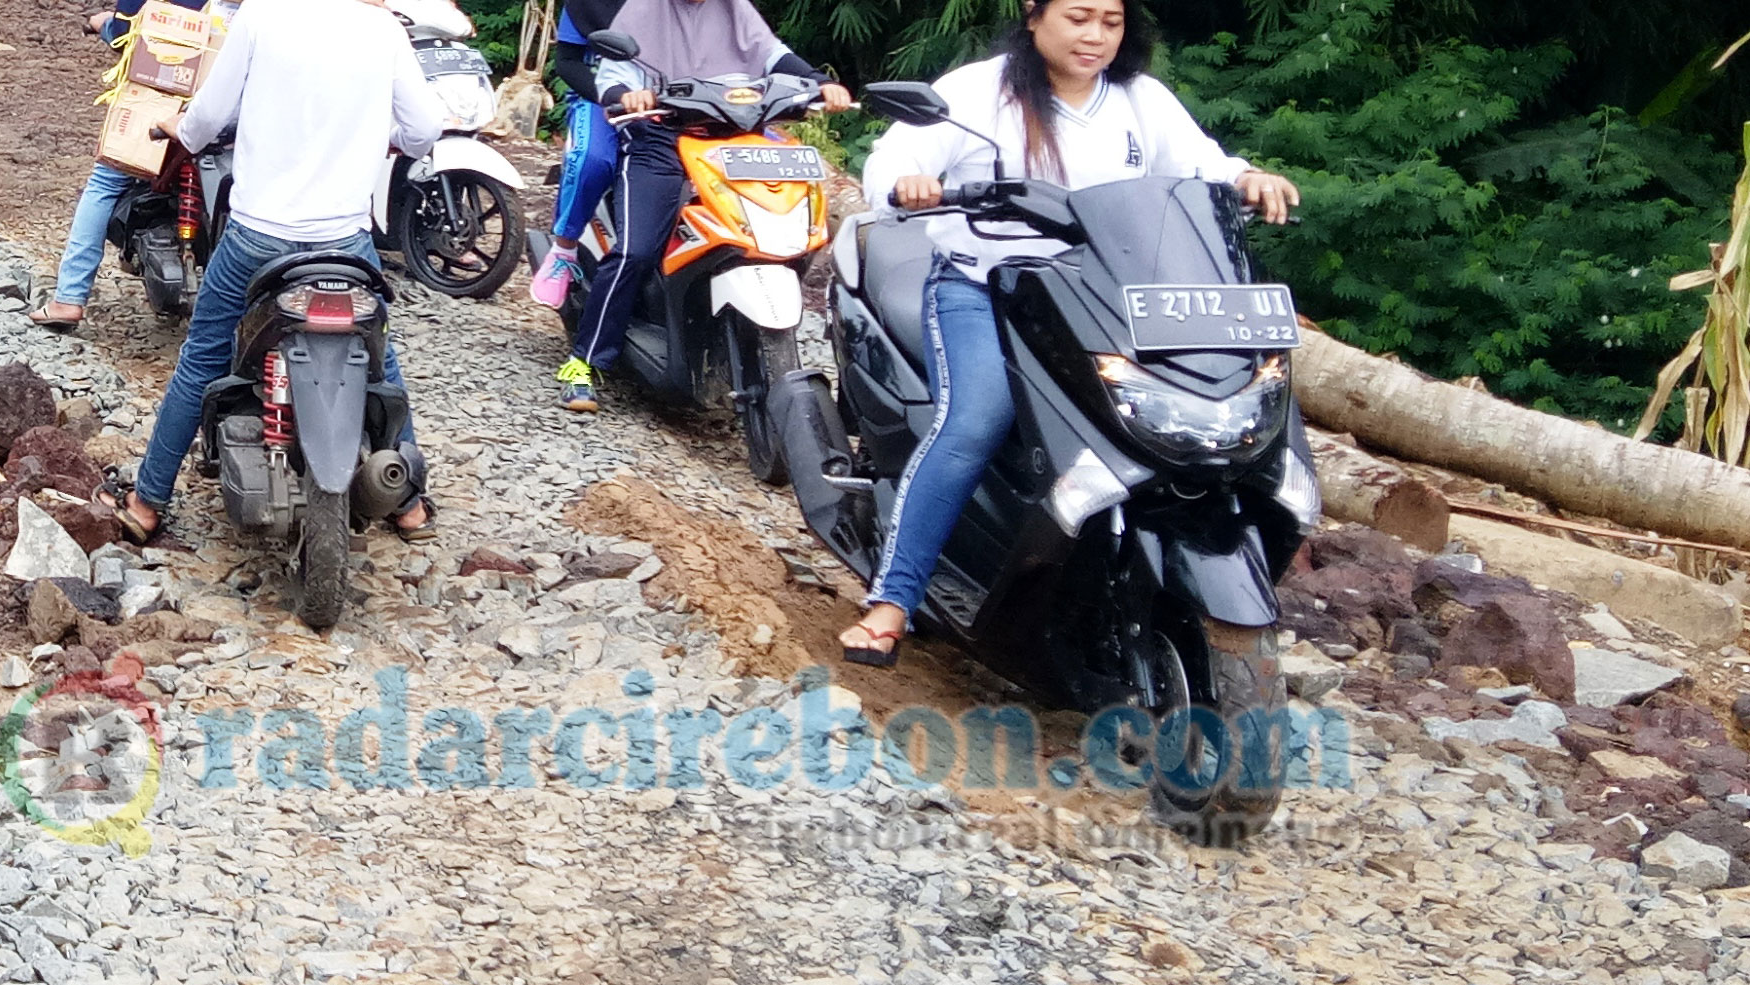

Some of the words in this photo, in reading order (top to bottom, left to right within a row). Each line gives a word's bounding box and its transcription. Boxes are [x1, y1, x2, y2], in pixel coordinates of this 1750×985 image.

[150, 11, 204, 33] sarimi
[721, 148, 734, 163] E
[317, 279, 349, 289] YAMAHA
[1130, 292, 1149, 317] E
[1159, 290, 1226, 317] 2712
[1253, 290, 1288, 317] UI
[1227, 326, 1294, 341] 10-22
